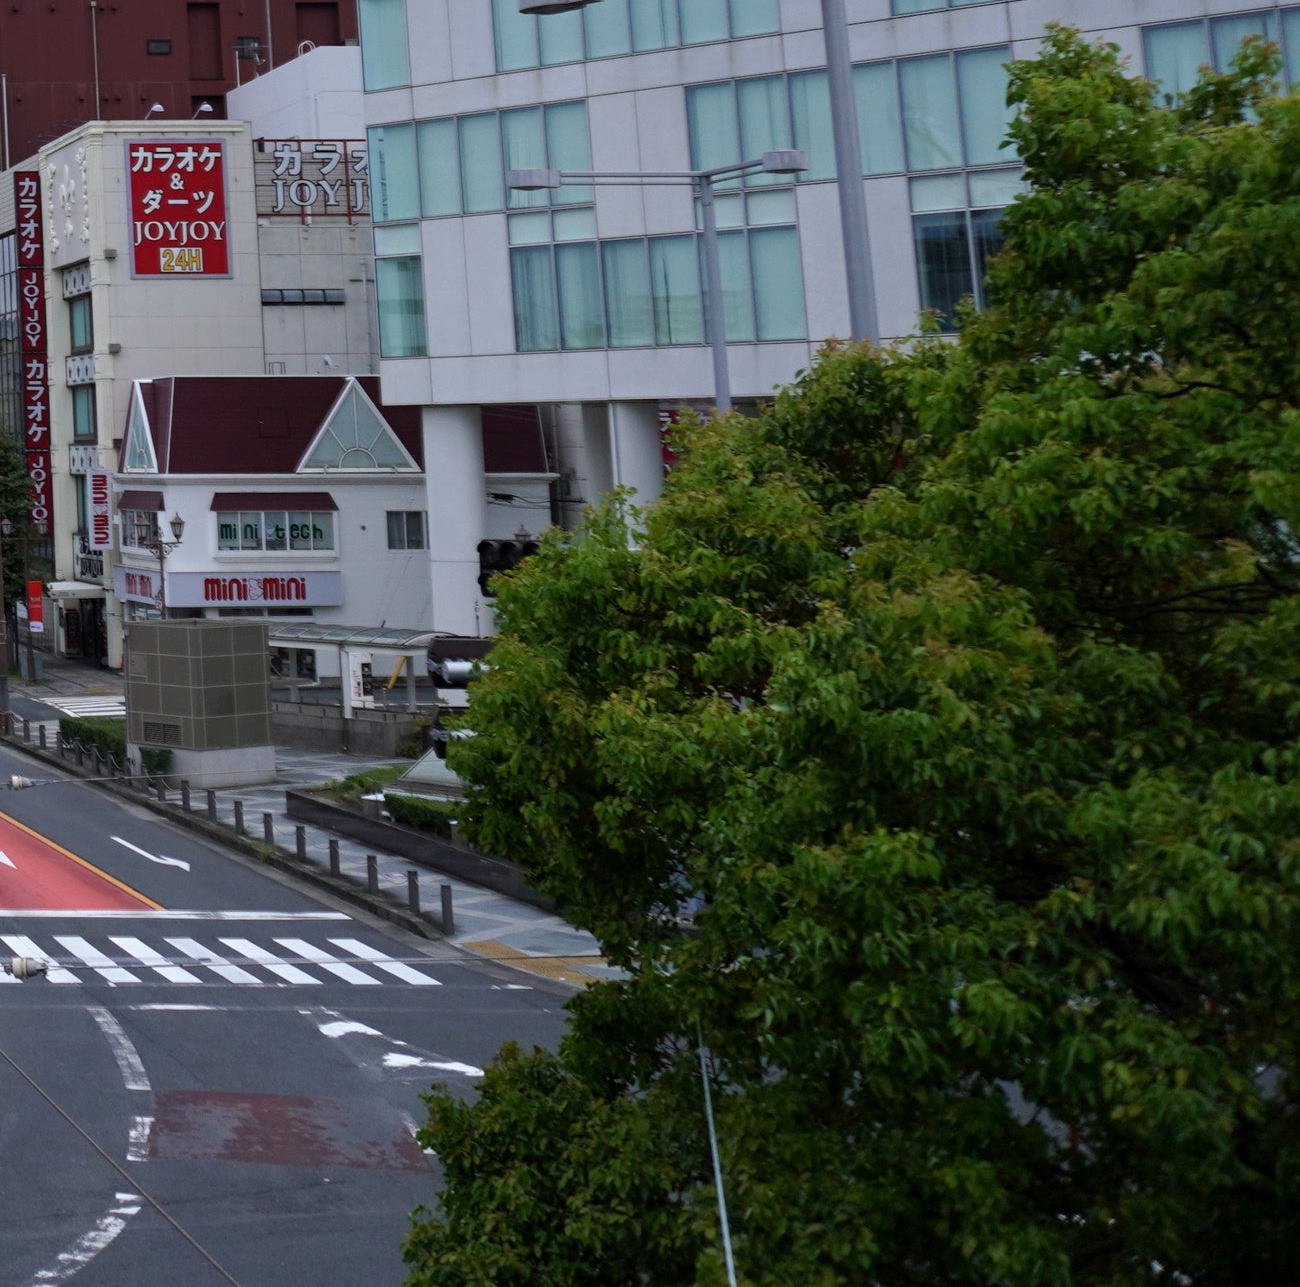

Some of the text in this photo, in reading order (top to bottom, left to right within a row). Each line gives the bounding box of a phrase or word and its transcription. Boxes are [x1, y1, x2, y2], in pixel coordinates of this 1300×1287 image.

[131, 146, 222, 172] カラオケ
[169, 173, 185, 190] &
[142, 189, 215, 215] ダーツ
[18, 177, 41, 259] カラオケ
[134, 220, 226, 246] JOYJOY
[161, 248, 201, 271] 24H
[23, 272, 42, 347] JOYJOY
[26, 360, 48, 443] カラオケ
[92, 474, 110, 545] mini mini
[274, 523, 323, 540] tech
[204, 577, 307, 601] mini mini
